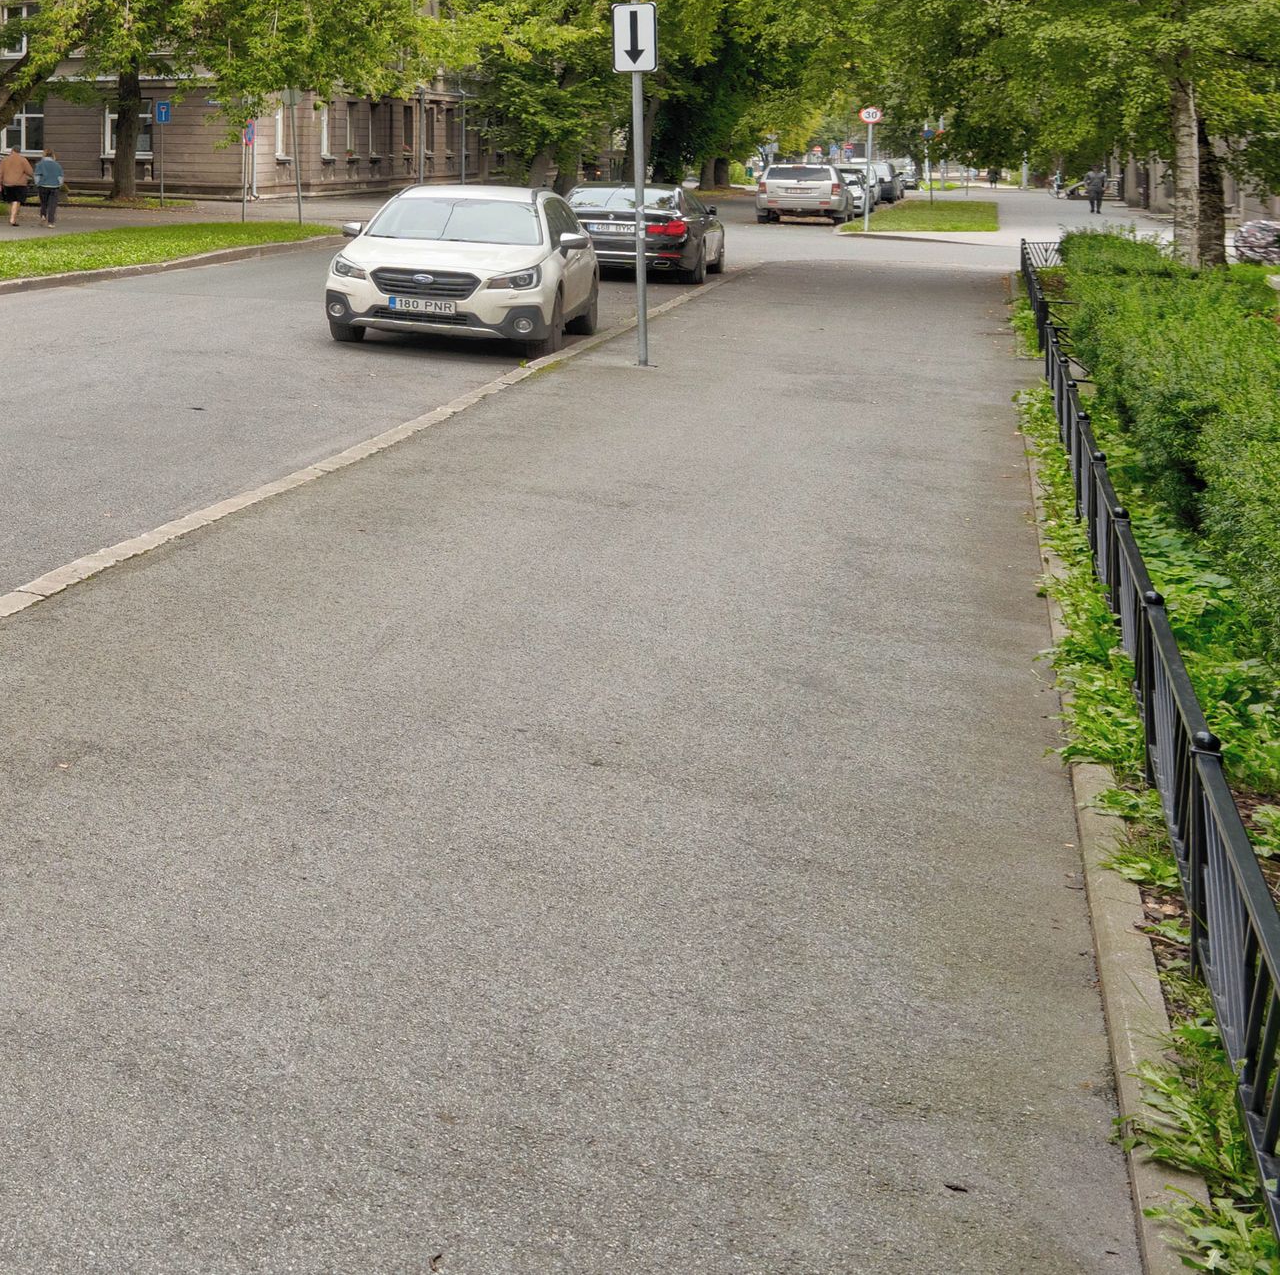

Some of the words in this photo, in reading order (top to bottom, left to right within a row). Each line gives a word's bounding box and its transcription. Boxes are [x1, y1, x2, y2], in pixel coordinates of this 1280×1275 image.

[865, 111, 878, 119] 30
[398, 299, 419, 309] 180
[425, 301, 453, 312] PNR
